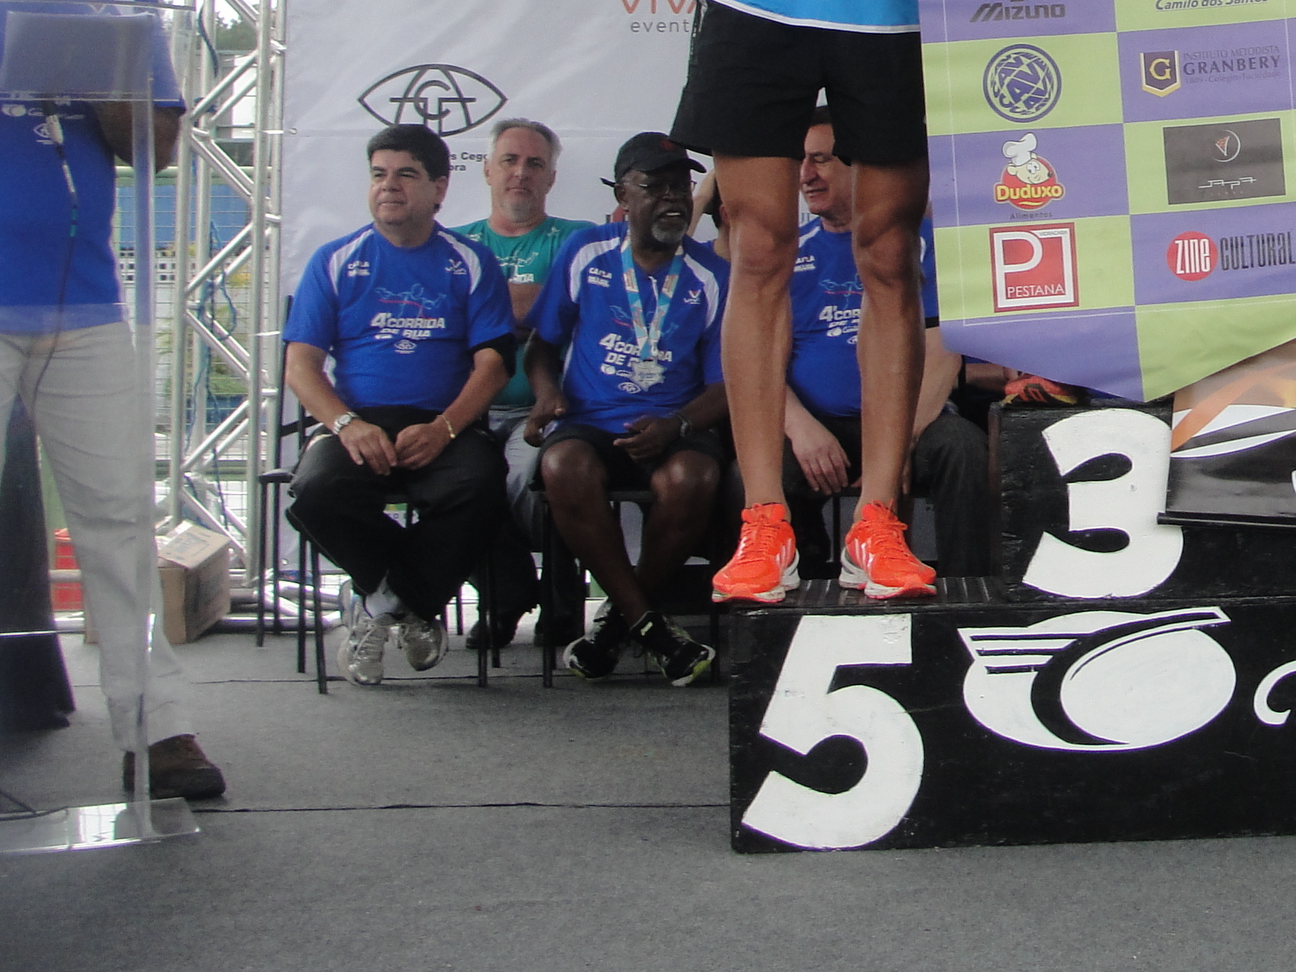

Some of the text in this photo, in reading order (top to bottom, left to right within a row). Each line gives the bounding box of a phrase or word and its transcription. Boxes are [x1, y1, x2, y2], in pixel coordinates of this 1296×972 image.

[969, 2, 1066, 22] MIZUNO
[630, 19, 690, 33] event
[1183, 45, 1280, 62] INSTITUTO METODISTA
[1183, 55, 1282, 76] GRANBERY
[996, 184, 1063, 201] Duduxo
[1010, 212, 1053, 220] Alimentos
[1007, 284, 1065, 298] PESTANA
[387, 317, 445, 328] CORRIDA
[605, 353, 627, 366] DE
[1022, 407, 1184, 598] 3
[742, 614, 924, 851] 5
